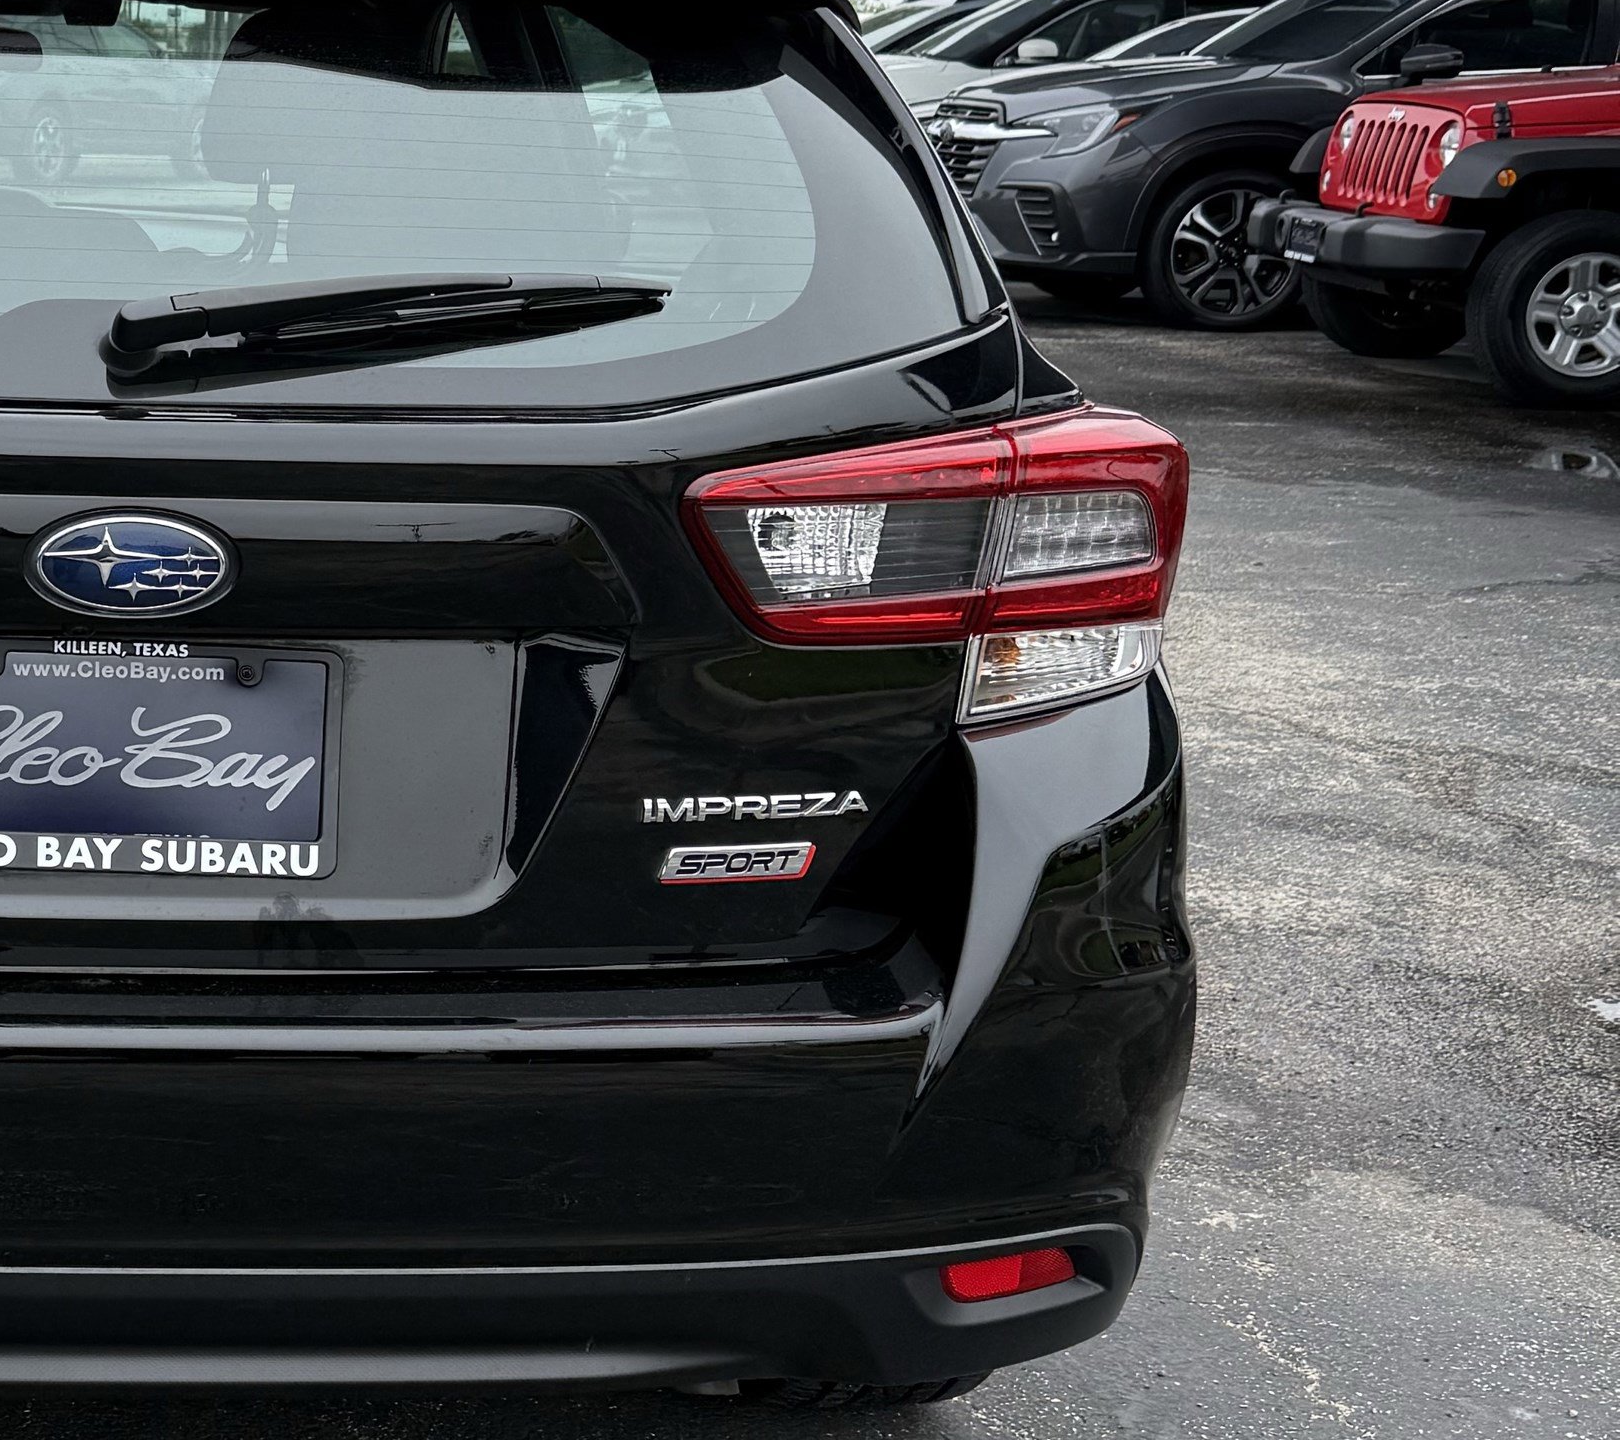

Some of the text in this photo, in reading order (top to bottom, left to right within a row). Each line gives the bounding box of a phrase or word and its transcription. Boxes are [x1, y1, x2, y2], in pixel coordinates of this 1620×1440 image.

[53, 640, 189, 658] KILLEEN, TEXAS
[12, 660, 226, 683] www.CleoBay.com
[119, 706, 316, 812] Bay
[641, 790, 870, 824] IMPREZA
[36, 835, 124, 870] BAY
[139, 838, 320, 878] SUBARU
[675, 849, 801, 876] SPORT
